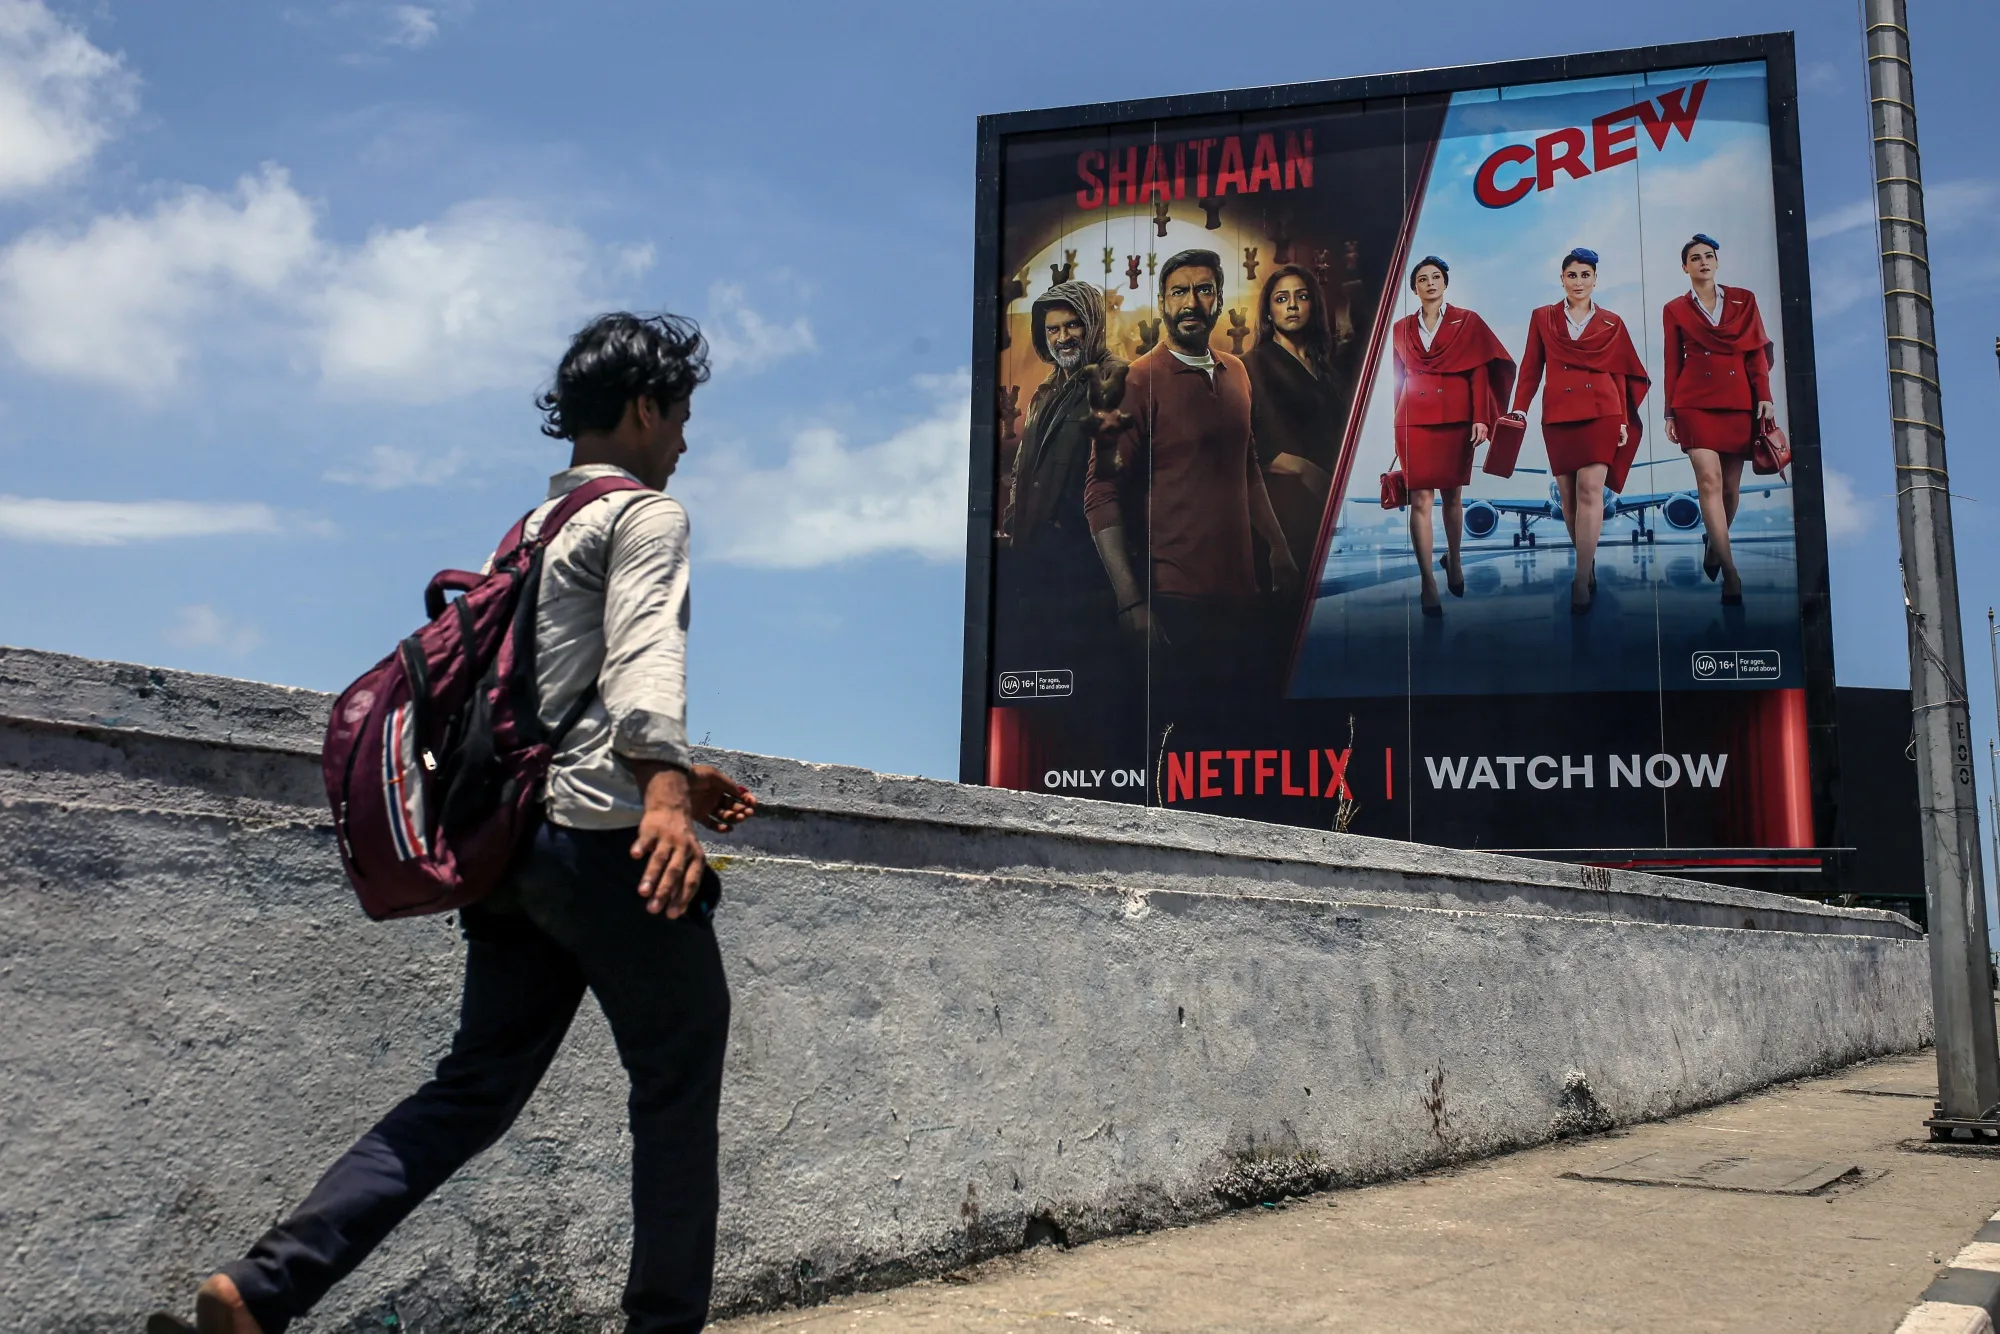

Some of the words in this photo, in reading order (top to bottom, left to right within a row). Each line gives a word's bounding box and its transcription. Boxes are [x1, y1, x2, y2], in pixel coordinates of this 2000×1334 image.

[1473, 78, 1709, 209] CREW
[1076, 128, 1314, 211] SHAITAAN
[1004, 680, 1018, 690] U/A
[1021, 680, 1035, 688] 16+
[1698, 660, 1714, 671] U/A
[1719, 660, 1735, 669] 16+
[1044, 769, 1106, 788] ONLY
[1110, 768, 1145, 787] ON
[1167, 748, 1353, 803] NETFLIX
[1424, 754, 1594, 790] WATCH
[1608, 753, 1728, 789] NOW
